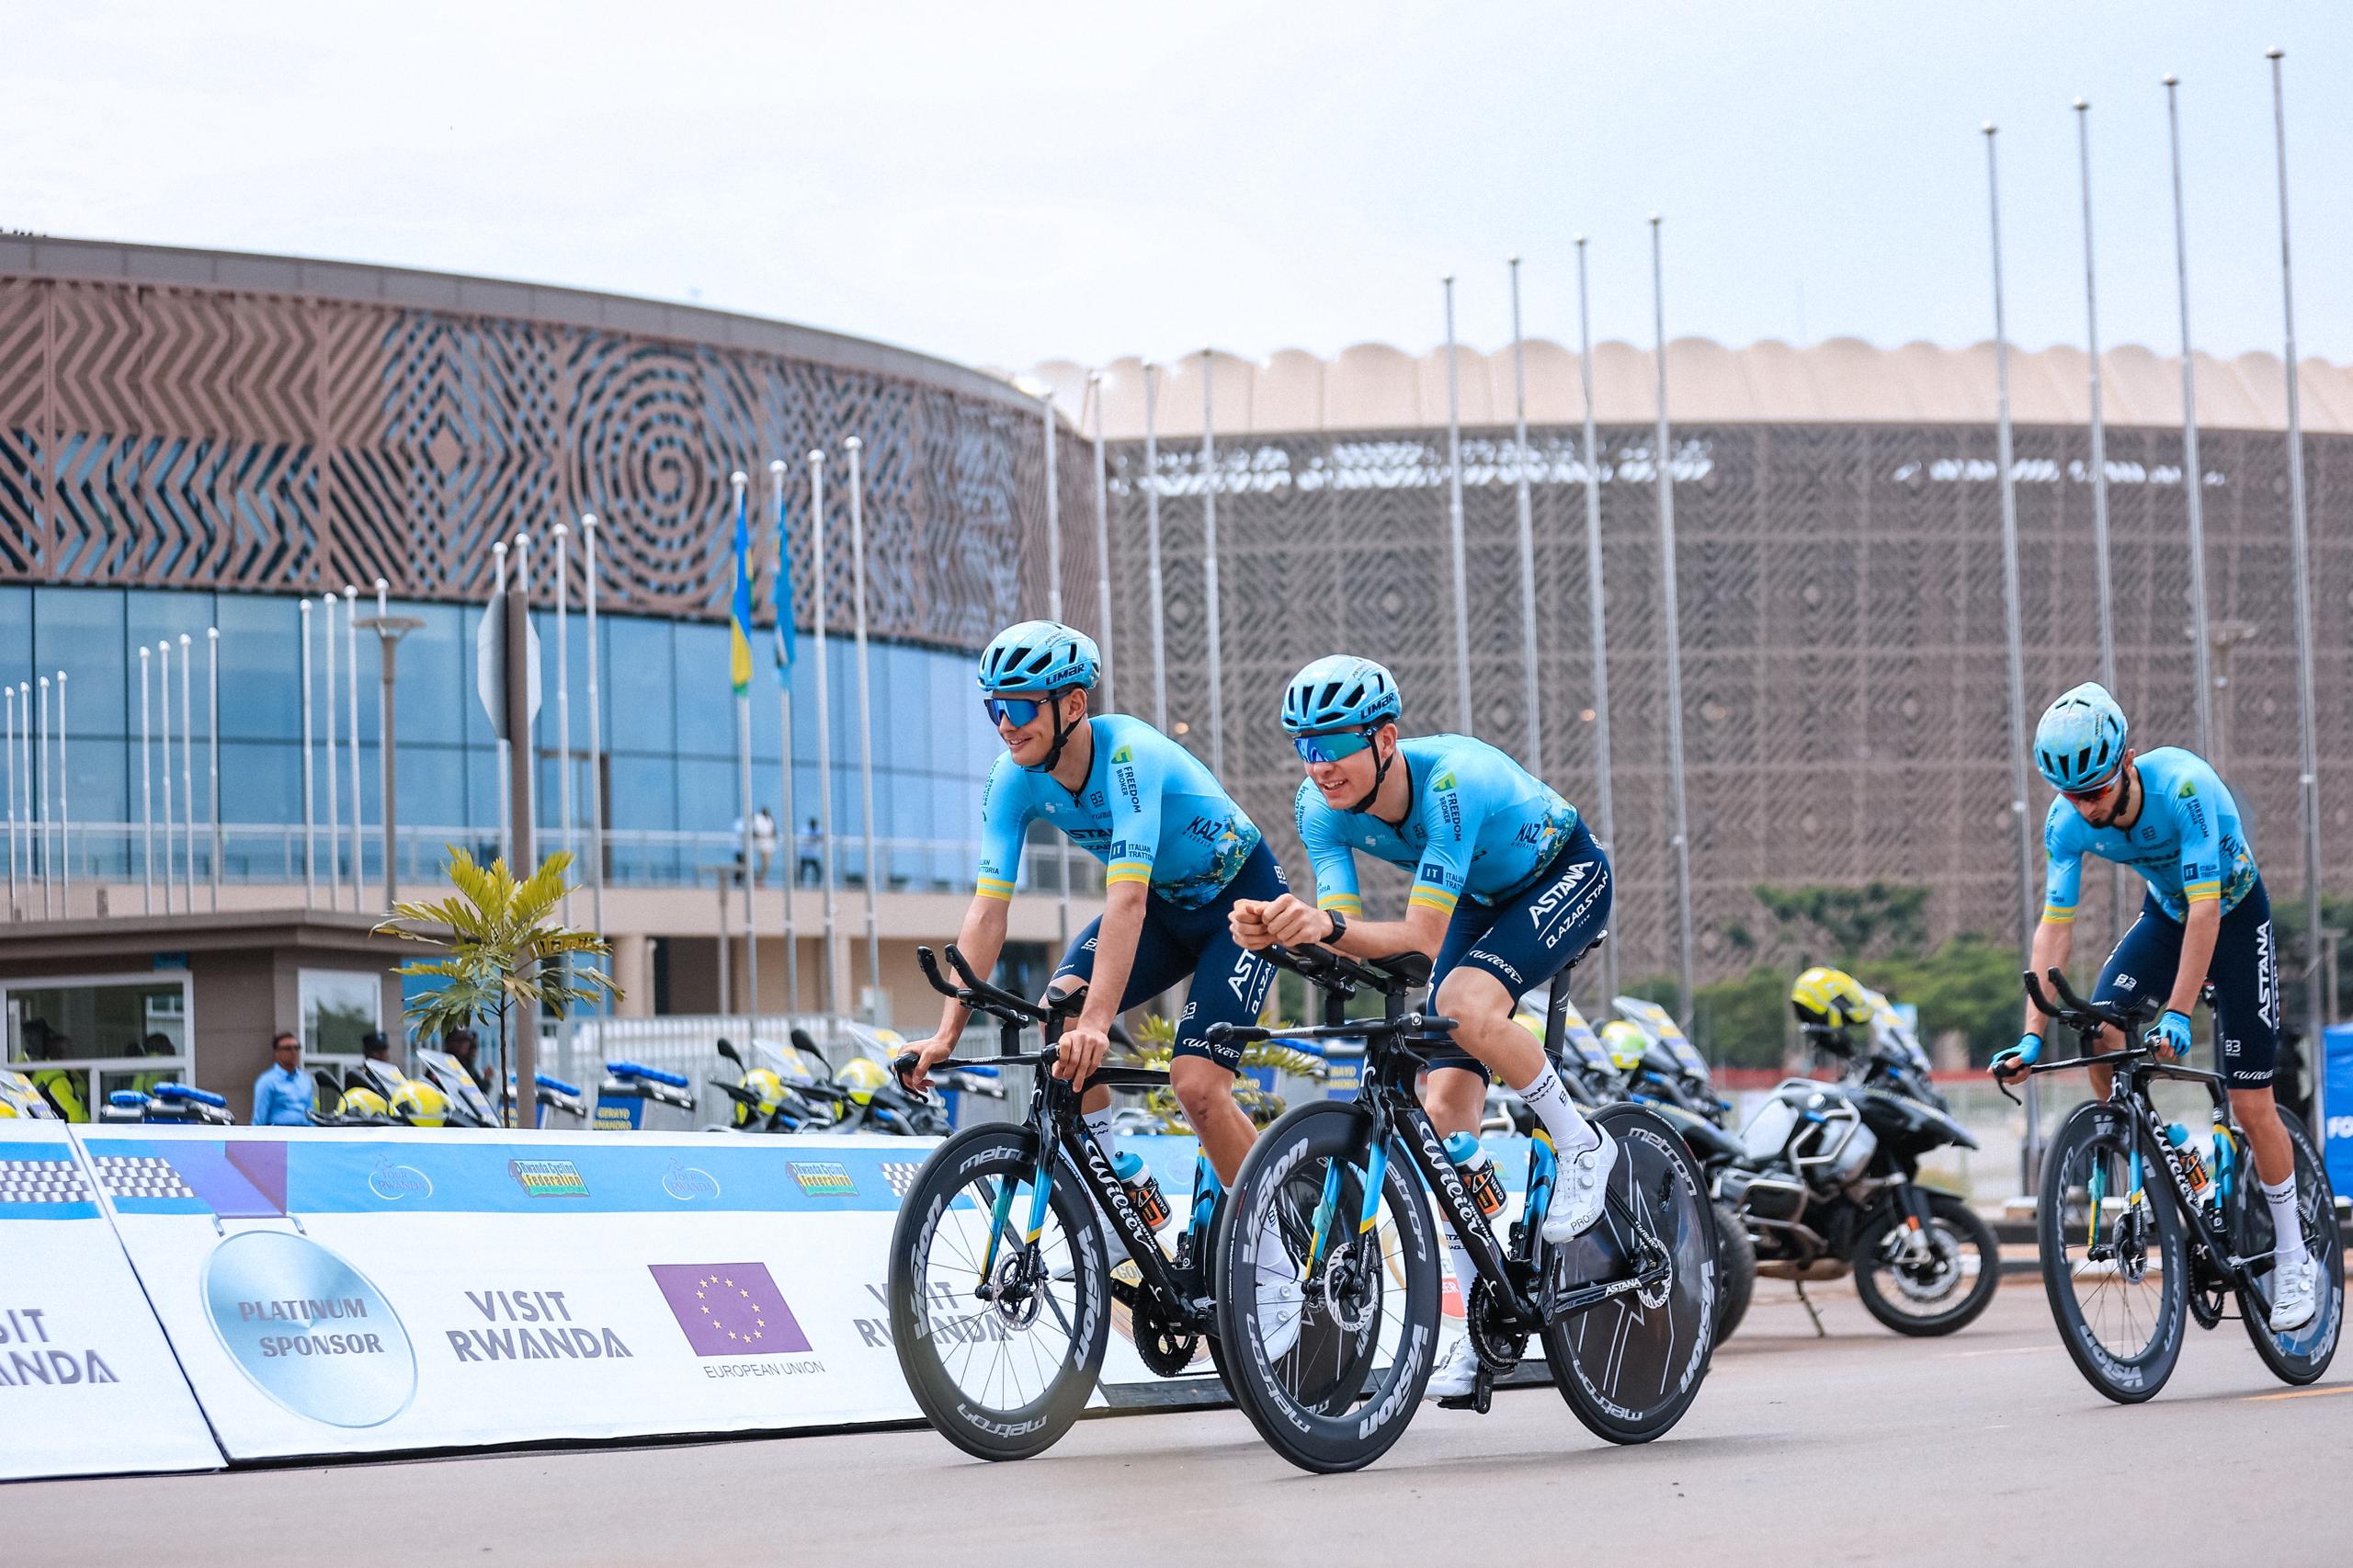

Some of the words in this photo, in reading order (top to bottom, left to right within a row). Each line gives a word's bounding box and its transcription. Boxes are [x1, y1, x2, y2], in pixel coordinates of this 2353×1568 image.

[1116, 768, 1129, 797] BROKER
[1123, 766, 1142, 813] FREEDOM
[1439, 796, 1450, 824] BROKER
[1447, 792, 1461, 842] FREEDOM
[1182, 815, 1223, 842] KAZ
[1515, 823, 1541, 845] KAZ
[1113, 845, 1122, 856] IT
[1128, 844, 1152, 853] ITALIAN
[1427, 868, 1438, 879] IT
[1529, 861, 1595, 930] ASTANA
[1546, 870, 1608, 949] QAZAQSTAN
[2256, 919, 2272, 1029] ASTANA
[520, 1162, 550, 1174] Rwanda
[548, 1162, 576, 1176] Cycling
[1628, 1128, 1697, 1196] metron
[526, 1175, 583, 1187] Federation
[801, 1176, 854, 1187] Federation
[1385, 1160, 1427, 1262] etron
[1468, 1200, 1493, 1244] TRIESTINA
[1132, 1211, 1157, 1251] TRIESTINA
[1605, 1278, 1643, 1297] ASTANA
[239, 1298, 369, 1323] PLATINUM
[465, 1290, 572, 1322] VISIT
[259, 1333, 385, 1358] SPONSOR
[445, 1327, 633, 1362] RWANDA
[703, 1362, 780, 1380] EUROPEAN
[780, 1360, 826, 1376] UNION
[1246, 1312, 1312, 1434] metron
[1573, 1359, 1643, 1421] metron
[957, 1403, 1048, 1438] metron
